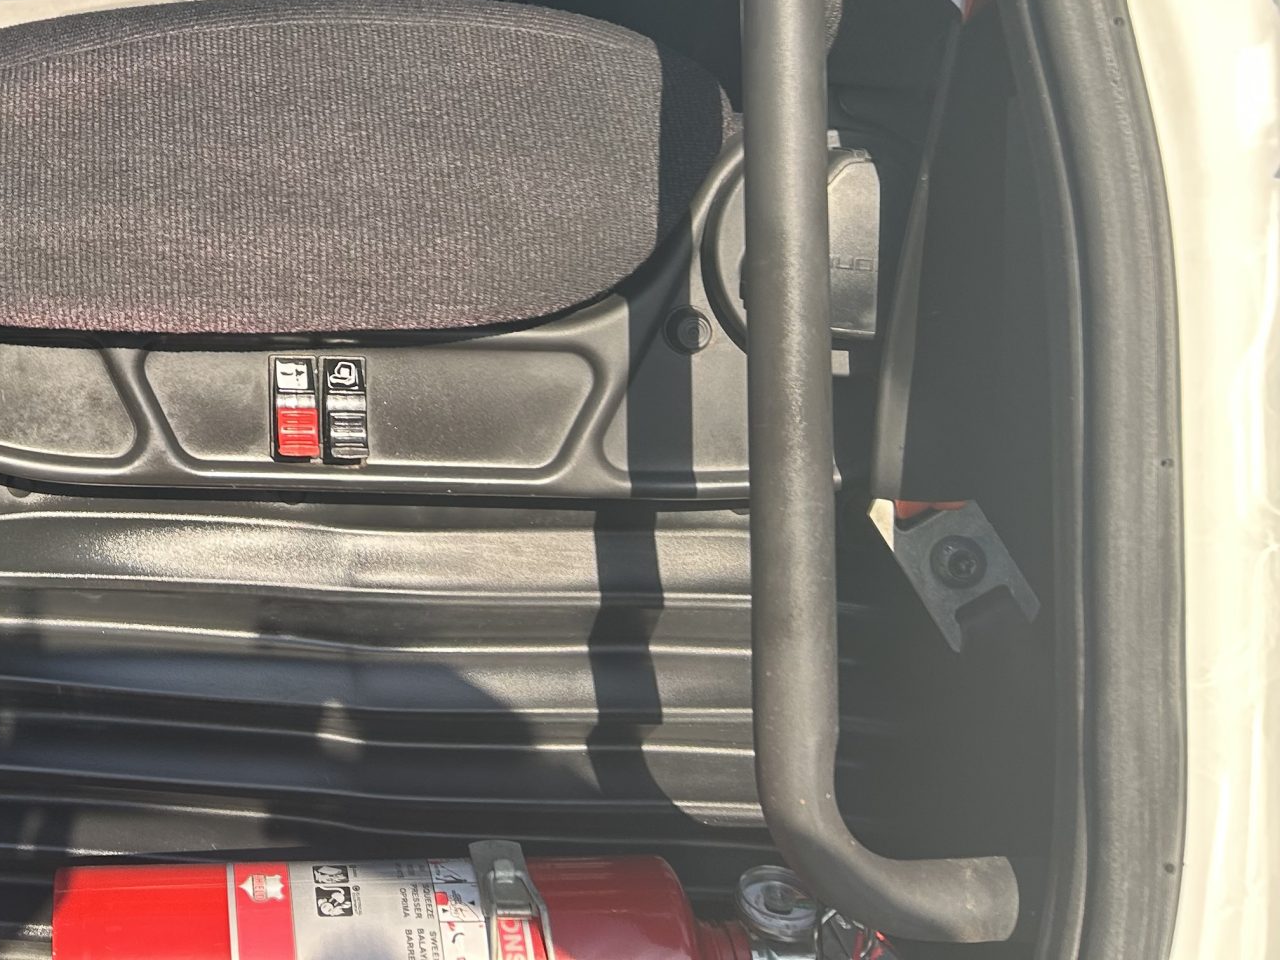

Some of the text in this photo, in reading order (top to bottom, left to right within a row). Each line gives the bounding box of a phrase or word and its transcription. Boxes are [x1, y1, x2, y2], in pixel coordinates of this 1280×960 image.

[399, 887, 409, 918] OPRIMA
[410, 883, 422, 919] PRESSER
[422, 883, 434, 919] SQUEEZE
[417, 928, 428, 960] BALAY
